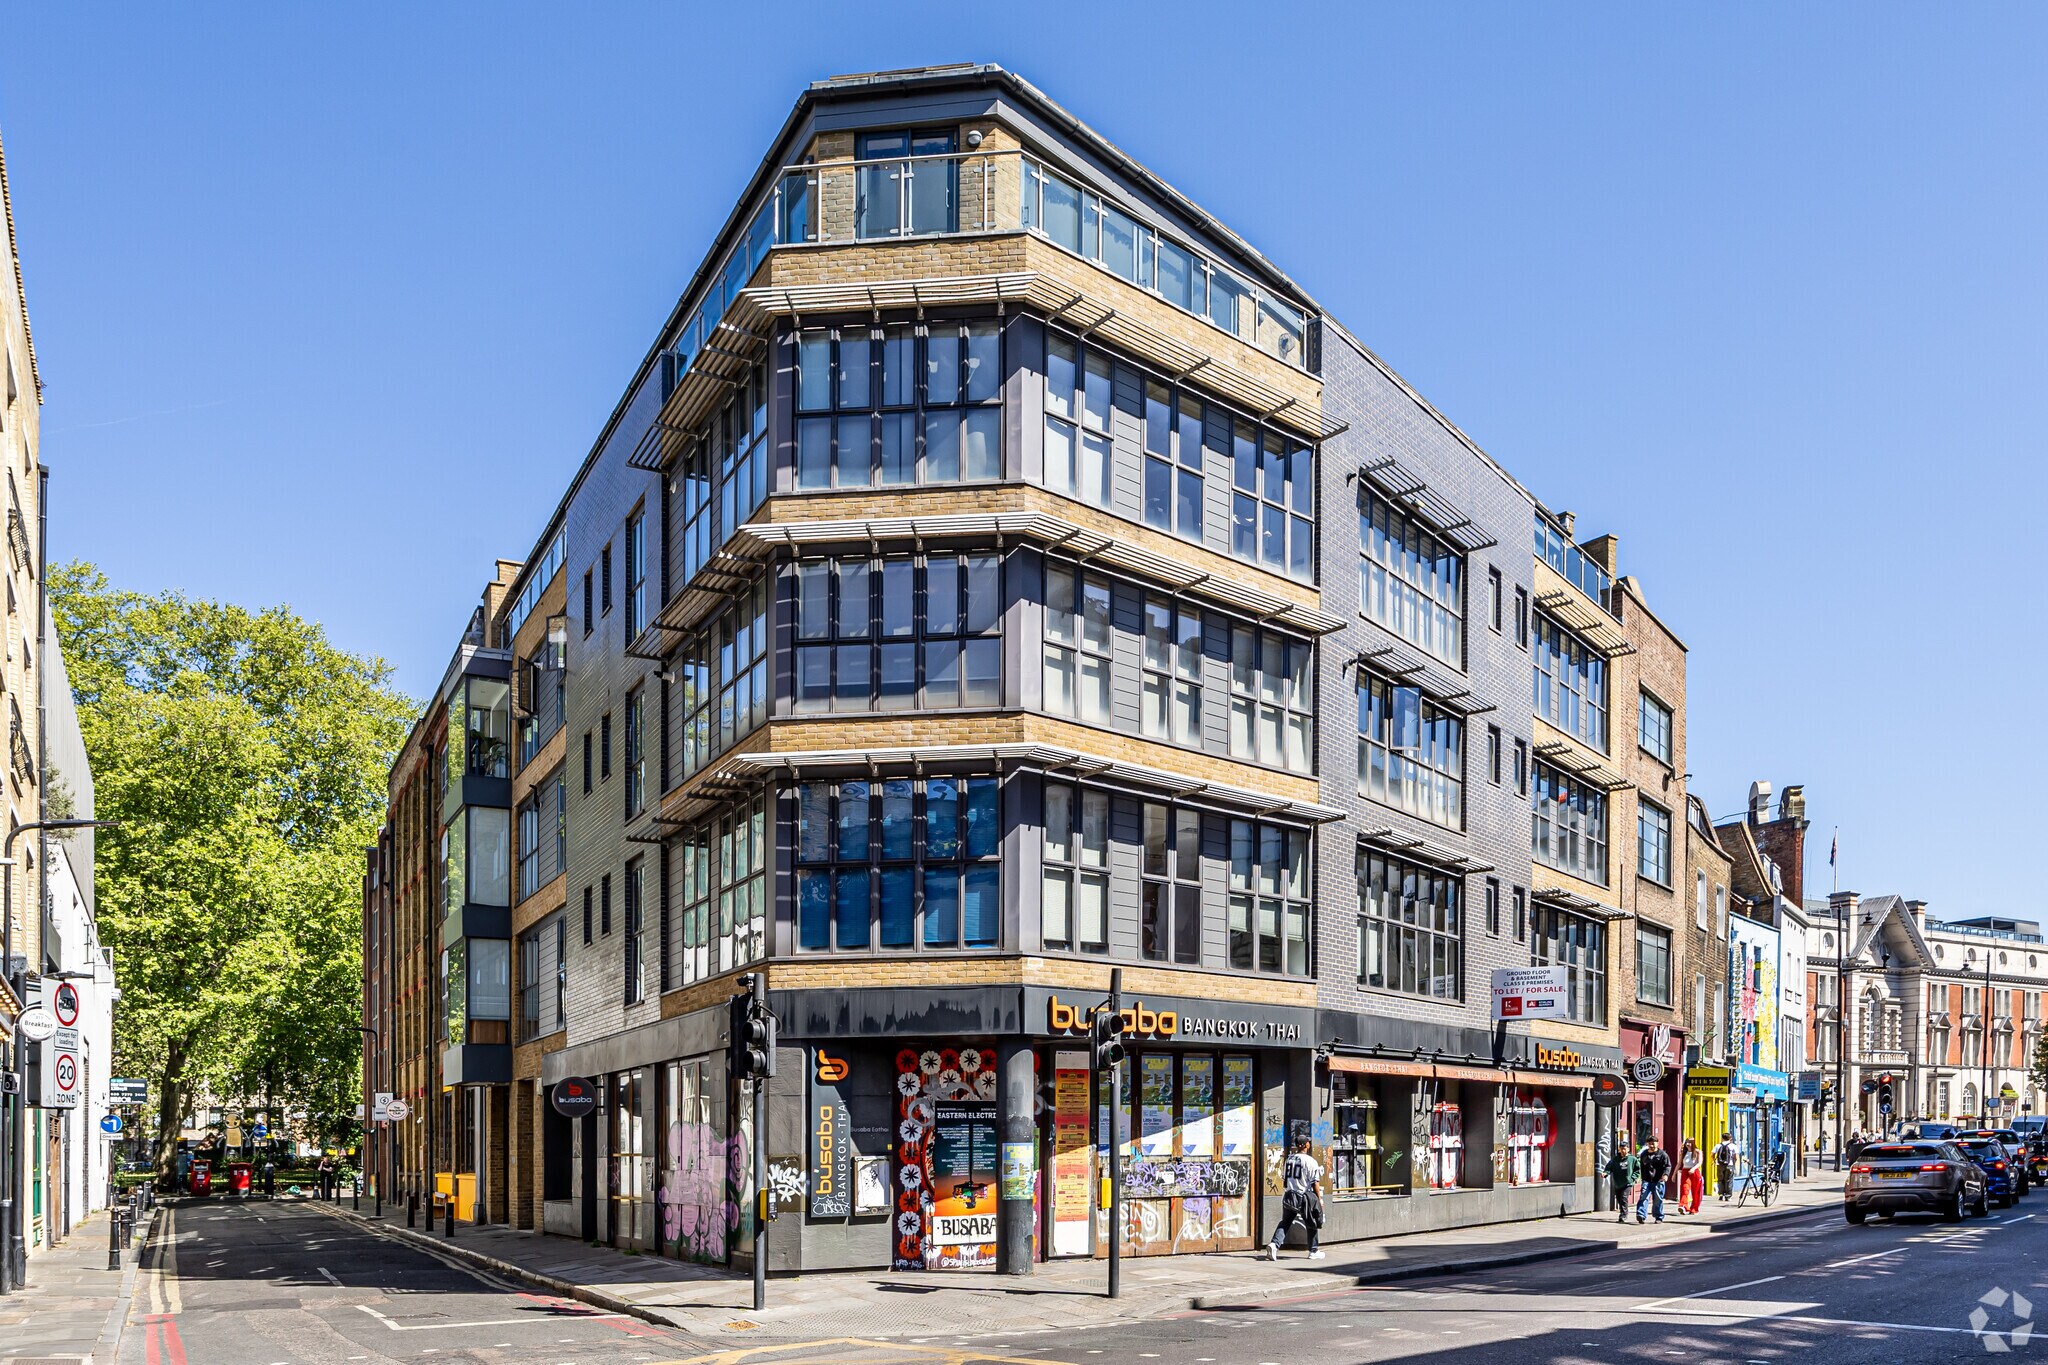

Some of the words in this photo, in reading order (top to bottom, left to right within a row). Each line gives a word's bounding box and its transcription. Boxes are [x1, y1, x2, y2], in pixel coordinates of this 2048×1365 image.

[1506, 987, 1519, 995] LET
[1544, 985, 1563, 993] SALE
[24, 1020, 53, 1029] Breakfast
[1184, 1017, 1258, 1036] BANGKOK
[1268, 1022, 1301, 1039] THAI
[56, 1030, 70, 1038] Except
[59, 1038, 74, 1046] loading
[1538, 1042, 1580, 1067] busaba
[1580, 1055, 1606, 1068] BANGKOK
[59, 1064, 74, 1080] 20
[1638, 1062, 1652, 1071] SIP
[1639, 1069, 1657, 1078] TELL
[56, 1093, 76, 1104] ZONE
[837, 1100, 847, 1128] THAI
[816, 1106, 833, 1194] busaba
[837, 1137, 847, 1197] BANGKOK
